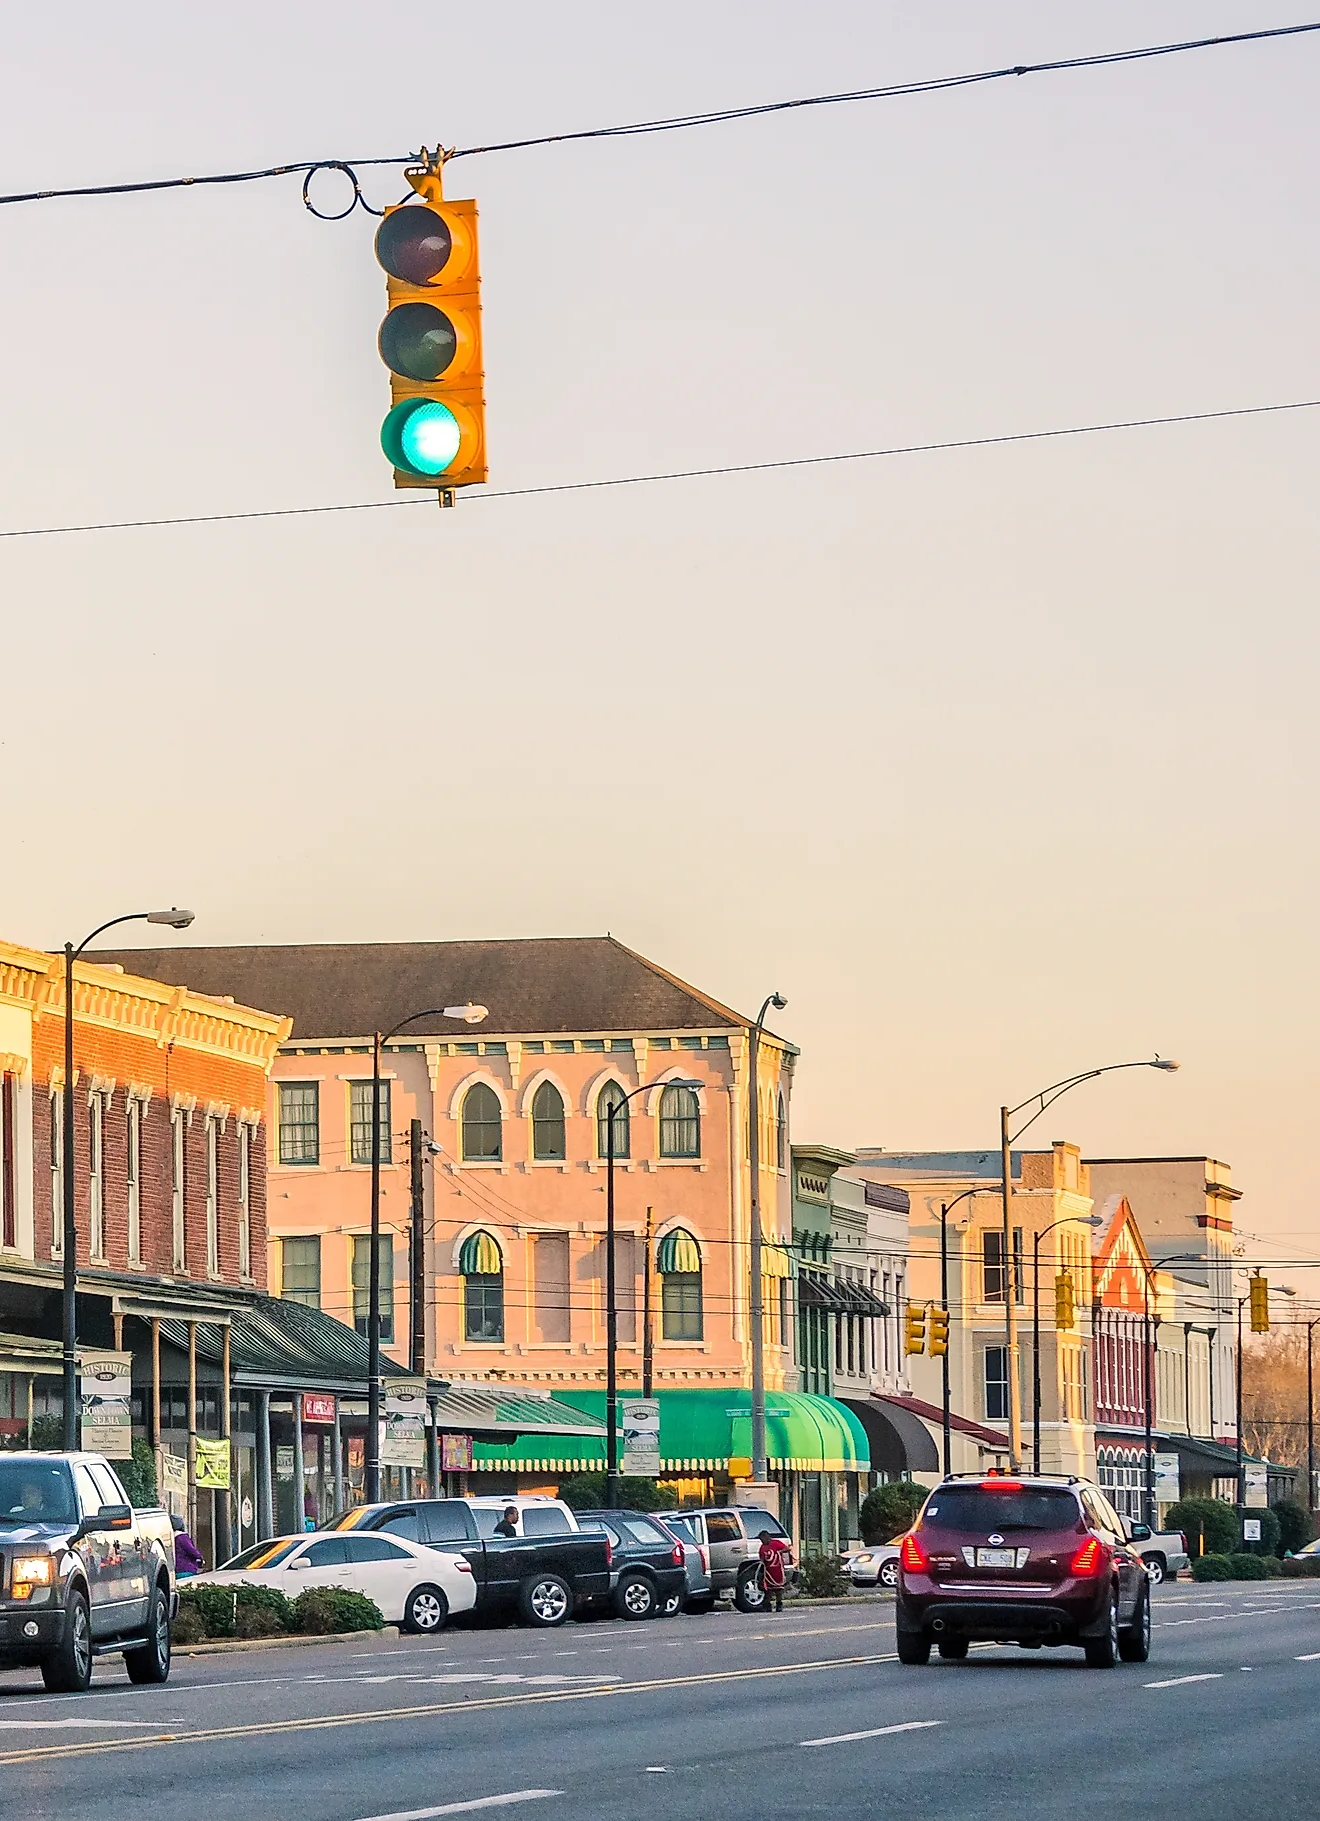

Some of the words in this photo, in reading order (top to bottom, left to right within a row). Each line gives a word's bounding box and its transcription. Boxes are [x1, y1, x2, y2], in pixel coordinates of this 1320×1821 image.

[83, 1362, 128, 1376] HISTORIC
[387, 1386, 424, 1397] HISTORIC
[92, 1415, 120, 1425] SELMA
